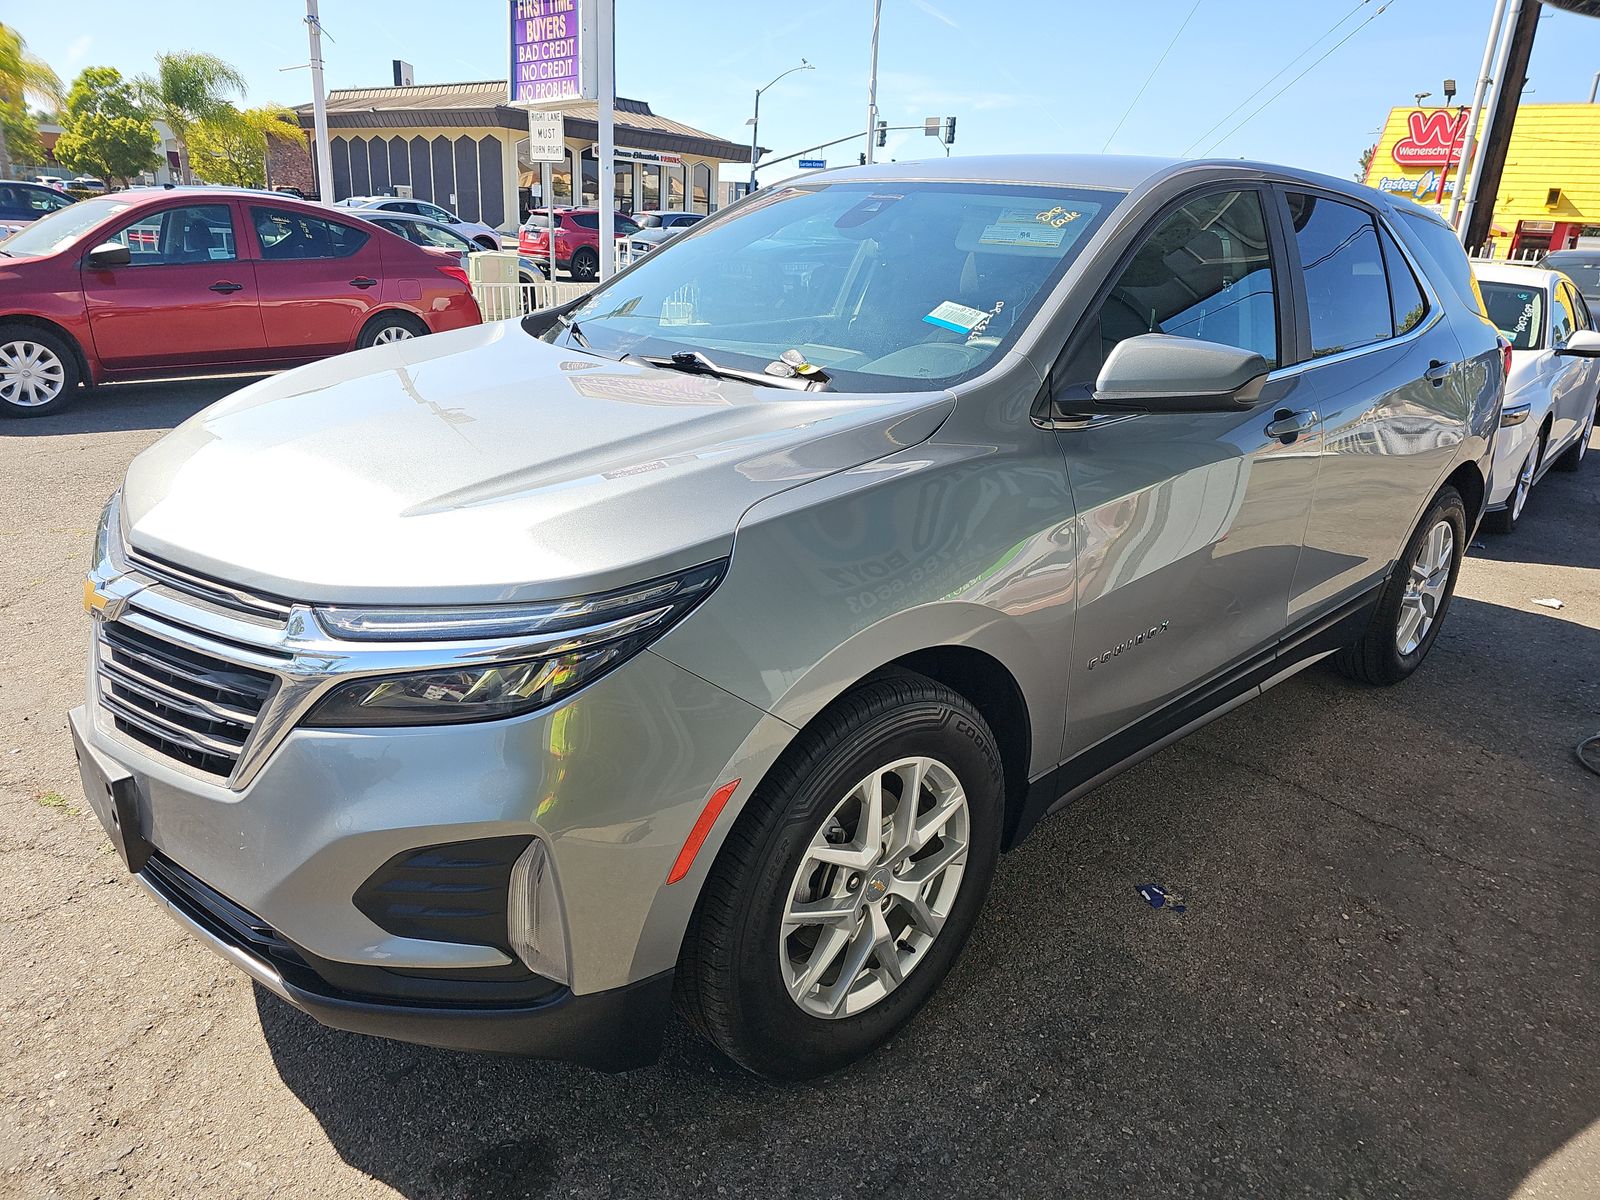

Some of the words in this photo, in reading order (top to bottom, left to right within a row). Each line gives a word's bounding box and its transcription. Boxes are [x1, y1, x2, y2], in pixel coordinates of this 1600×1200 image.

[517, 0, 546, 19] FIRST
[526, 14, 566, 43] BUYERS
[519, 43, 539, 62] BAD
[541, 38, 575, 60] CREDIT
[521, 63, 538, 81] NO
[540, 58, 573, 79] CREDIT
[520, 83, 534, 101] NO
[535, 79, 574, 100] PROBLEM
[531, 112, 545, 121] RIGHT
[548, 112, 560, 121] LANE
[537, 128, 555, 139] MUST
[532, 145, 546, 154] TURN
[547, 145, 562, 154] RIGHT
[1379, 177, 1418, 191] tastee
[1087, 619, 1170, 670] EQUINOX
